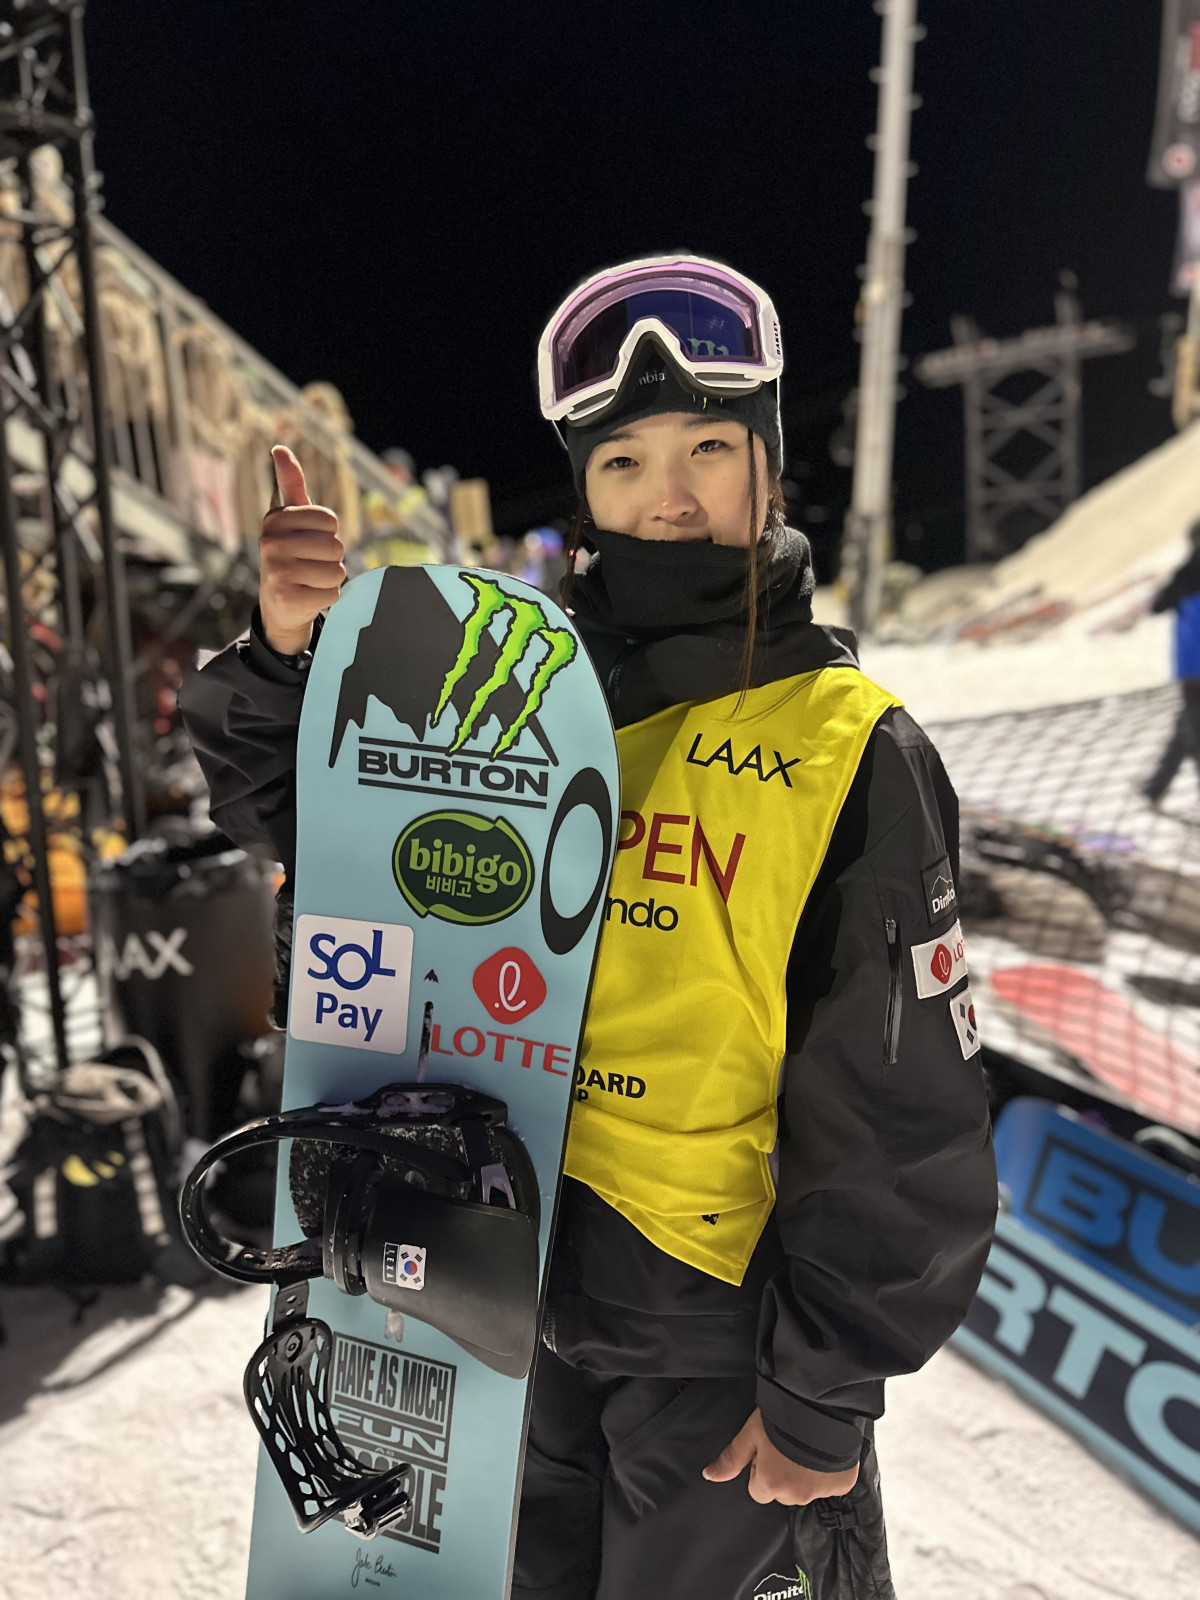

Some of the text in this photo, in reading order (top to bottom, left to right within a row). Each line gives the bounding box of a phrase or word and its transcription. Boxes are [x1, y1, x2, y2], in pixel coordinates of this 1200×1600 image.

[358, 748, 549, 797] BURTON
[685, 733, 802, 789] LAAX
[408, 838, 522, 894] bibigo
[425, 874, 472, 899] 비비고
[315, 991, 383, 1042] Pay
[430, 1024, 572, 1077] LOTTE
[335, 1341, 449, 1423] HAVE AS MUCH
